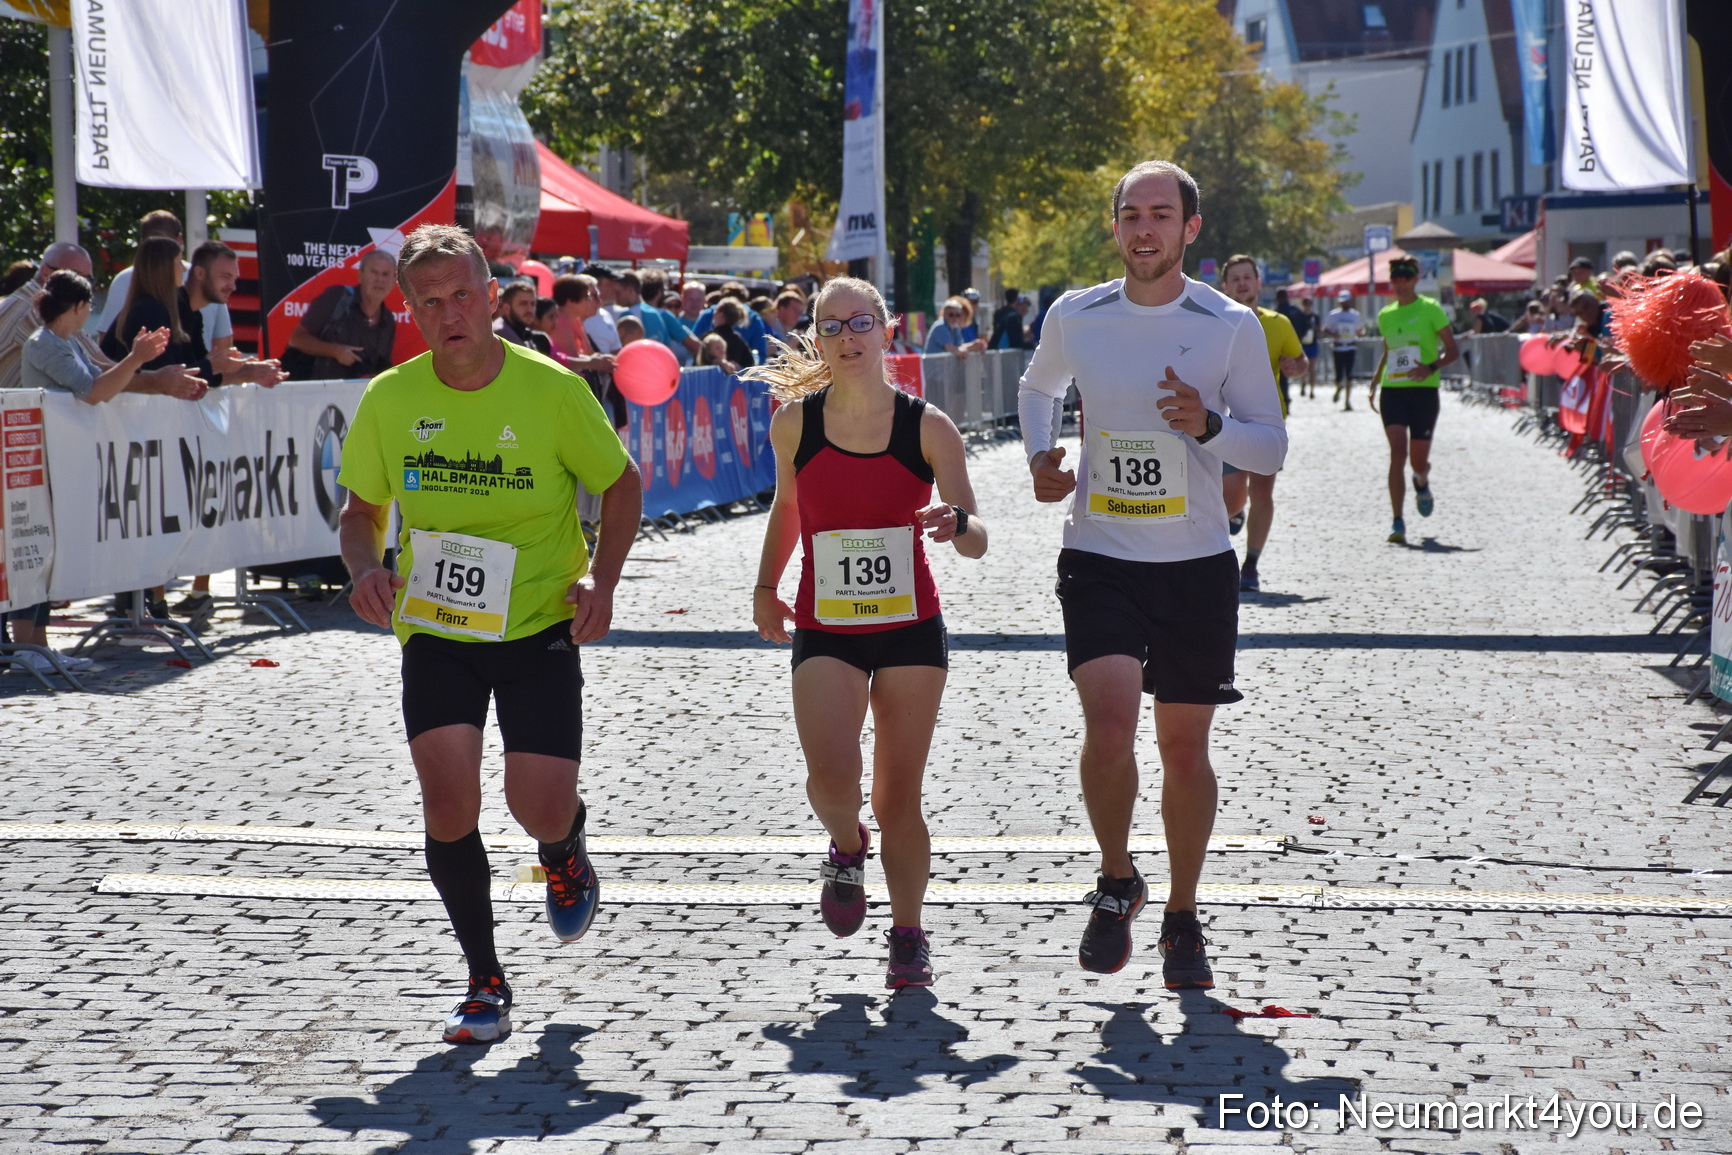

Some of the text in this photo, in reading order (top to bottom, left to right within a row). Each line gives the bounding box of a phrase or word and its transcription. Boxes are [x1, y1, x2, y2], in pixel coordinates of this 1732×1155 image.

[303, 242, 362, 257] THE NEXT
[286, 254, 345, 269] 100 YEARS
[1397, 356, 1409, 367] 66
[1110, 439, 1156, 451] BOCK
[1109, 456, 1162, 486] 138
[421, 470, 534, 490] HALBMARATHON
[421, 484, 490, 496] INGOLSTADT 2018
[1107, 486, 1157, 497] PARTL Neumarkt
[1107, 499, 1166, 515] Sebastian
[441, 540, 484, 559] BOCK
[842, 538, 885, 549] BOCK
[434, 559, 486, 597] 159
[838, 555, 892, 586] 139
[426, 590, 476, 608] PARTL Neumarkt
[857, 588, 887, 596] Neumarkt
[852, 602, 879, 615] Tina
[435, 607, 469, 626] Franz
